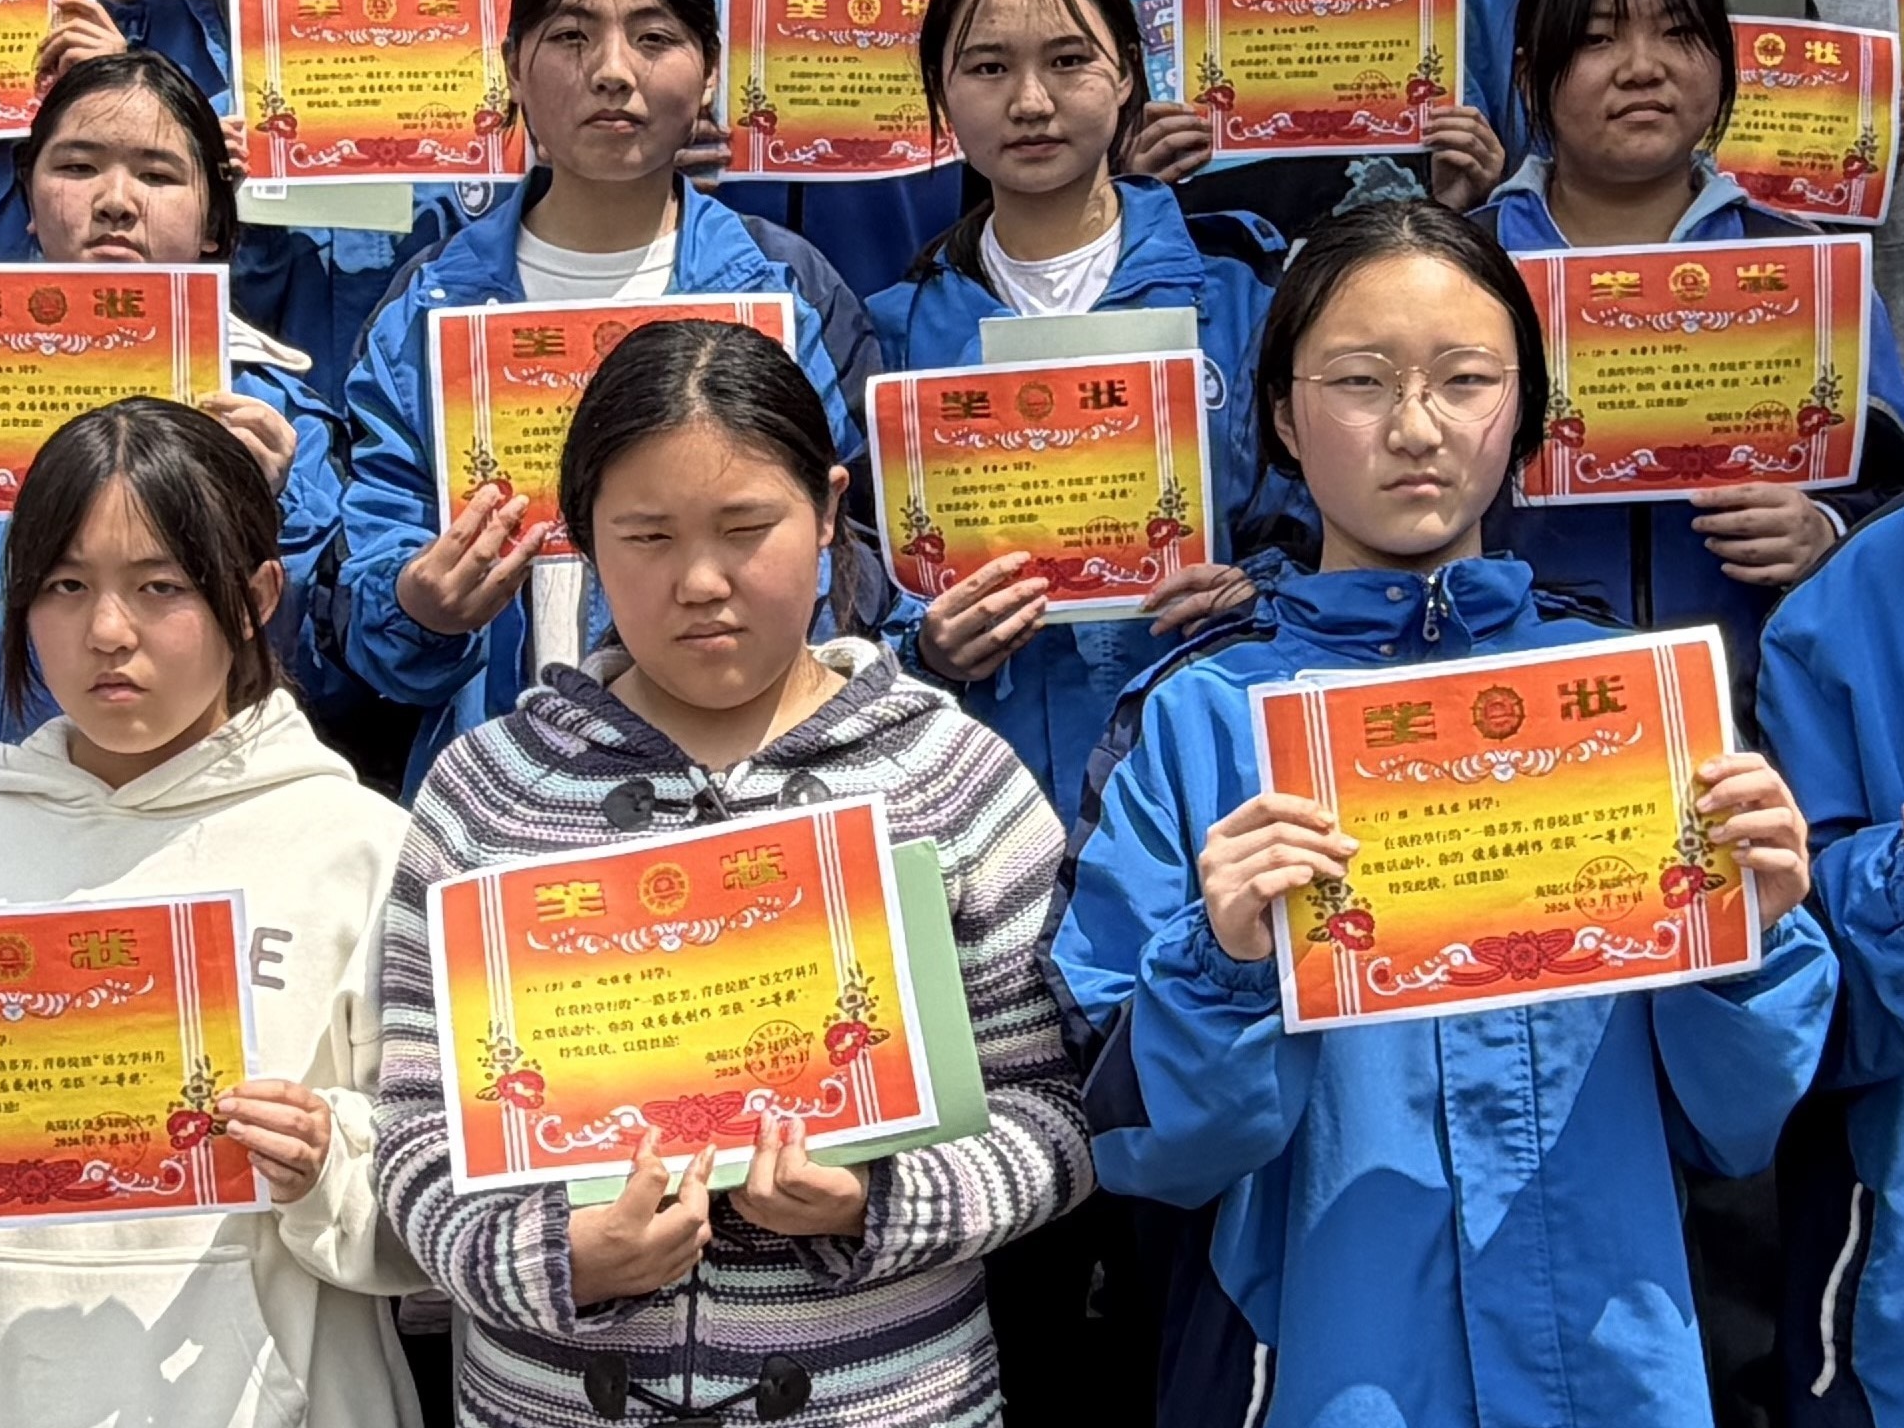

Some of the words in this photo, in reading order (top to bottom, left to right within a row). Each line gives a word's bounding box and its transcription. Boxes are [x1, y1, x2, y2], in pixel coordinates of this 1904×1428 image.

[1363, 701, 1436, 747] 奖
[1557, 675, 1626, 721] 状
[533, 880, 607, 922] 奖
[719, 843, 787, 889] 状
[69, 928, 139, 969] 状
